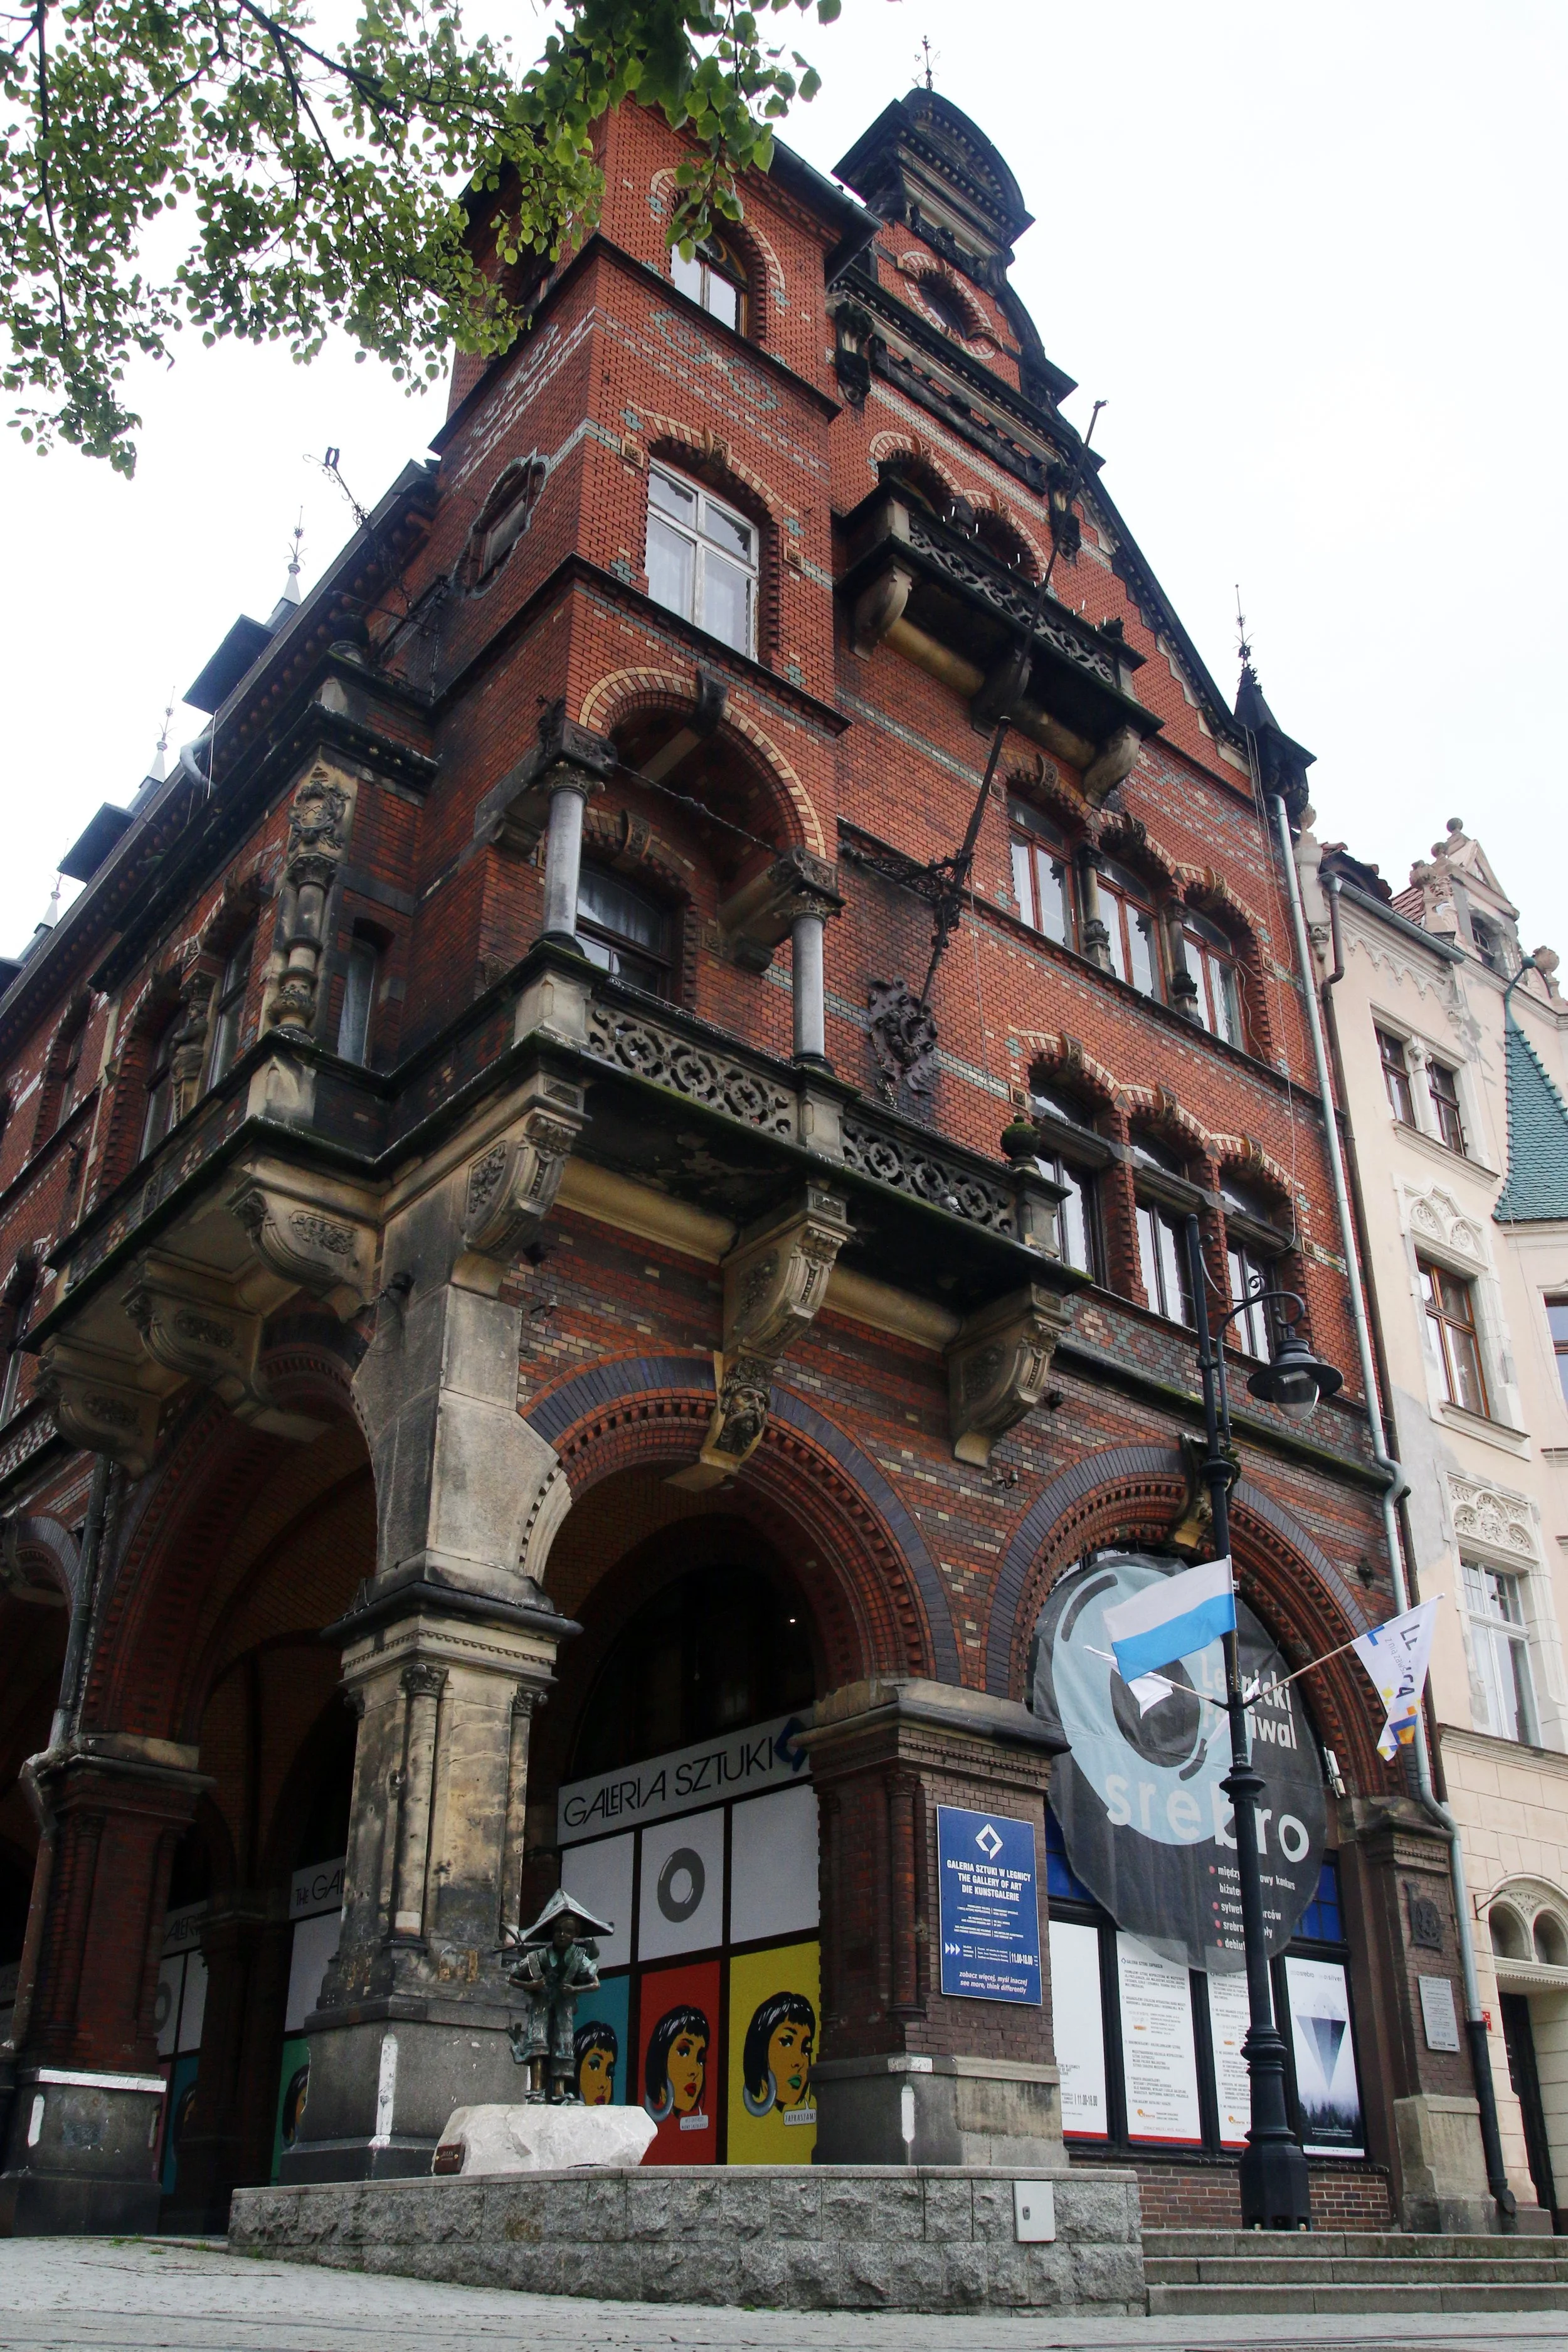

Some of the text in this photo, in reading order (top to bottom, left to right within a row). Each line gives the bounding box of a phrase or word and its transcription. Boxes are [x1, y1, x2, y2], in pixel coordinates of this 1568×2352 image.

[564, 1736, 773, 1827] GALERIA SZTUKI
[946, 1859, 1031, 1882] GALERIA SZTUKI W LEGNICY
[958, 1872, 1022, 1891] THE GALLERY OF ART
[961, 1884, 1020, 1902] DIE KUNSTGALERIE
[959, 1971, 1028, 1986] zobacz więcej, myśl inaczej
[1001, 1984, 1027, 1994] differently
